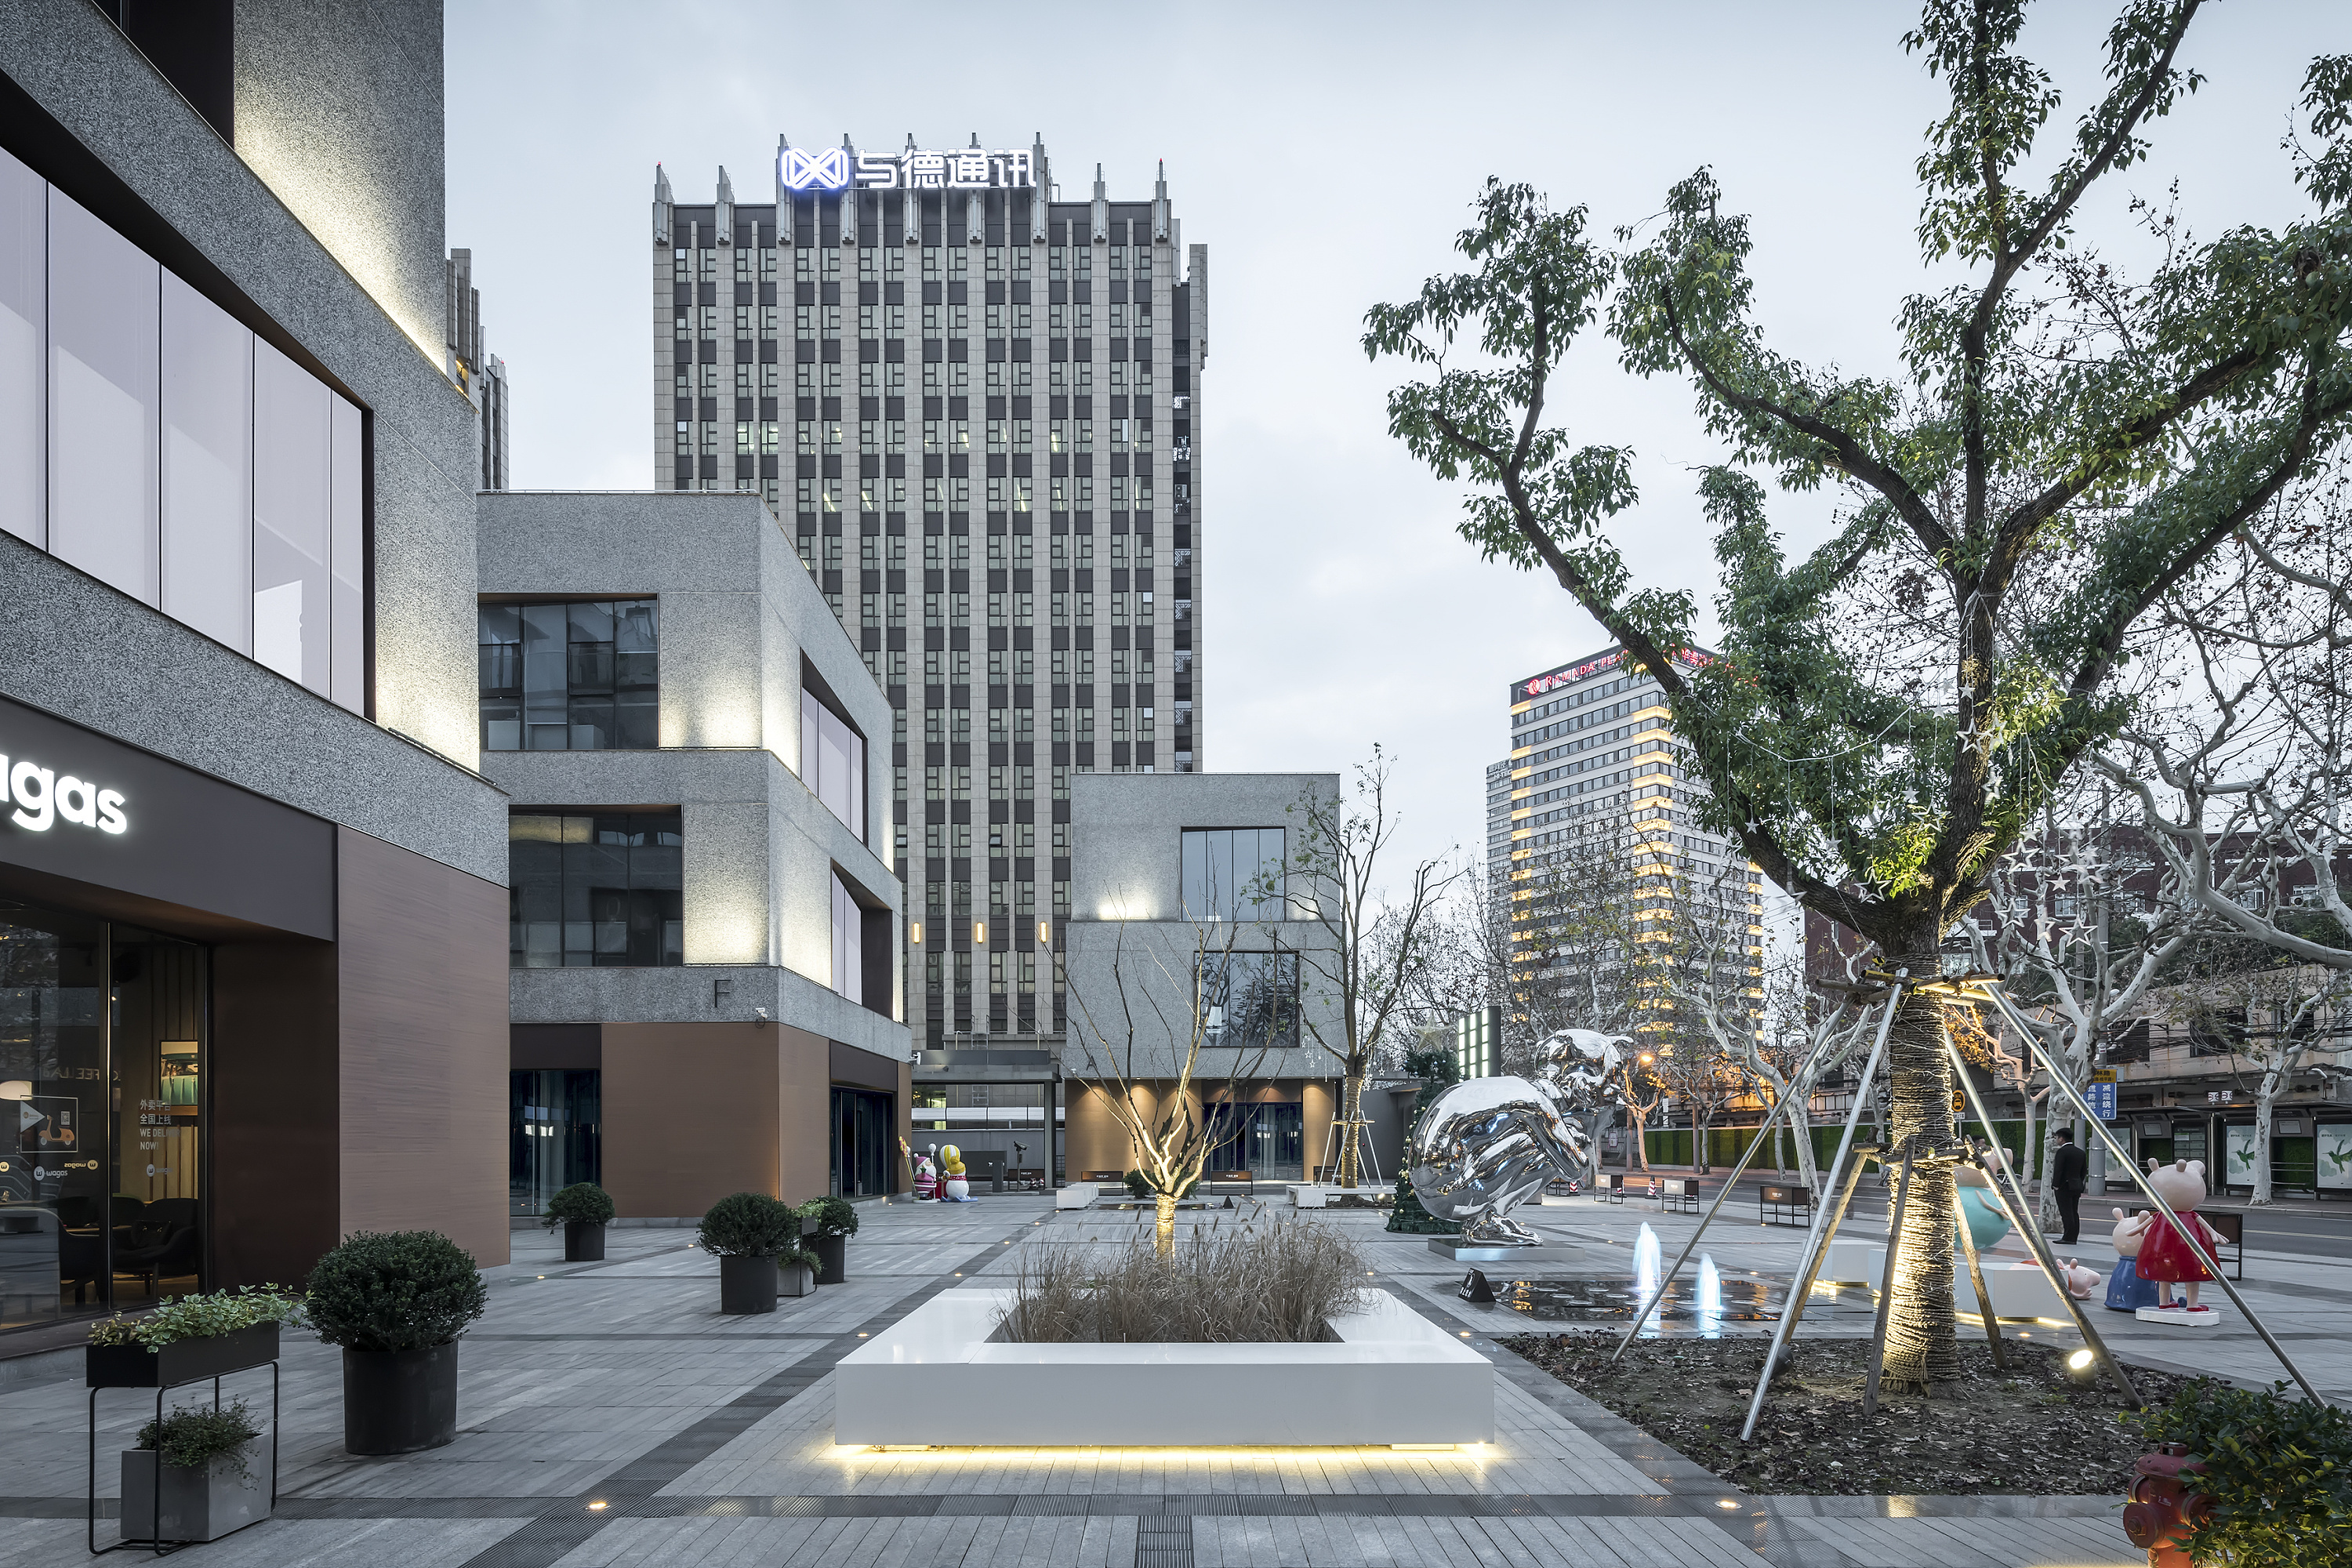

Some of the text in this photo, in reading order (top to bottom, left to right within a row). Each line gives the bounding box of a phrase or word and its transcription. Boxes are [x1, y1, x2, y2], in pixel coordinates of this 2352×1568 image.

[855, 148, 1037, 189] 与德通讯
[1544, 649, 1628, 687] RAMADA PLA
[0, 753, 127, 835] gas
[714, 979, 733, 1008] F
[140, 1099, 171, 1111] 外卖平台
[2087, 1085, 2096, 1109] 道路施
[140, 1113, 172, 1125] 全国上线
[140, 1128, 151, 1137] WE
[46, 1170, 68, 1178] wagas
